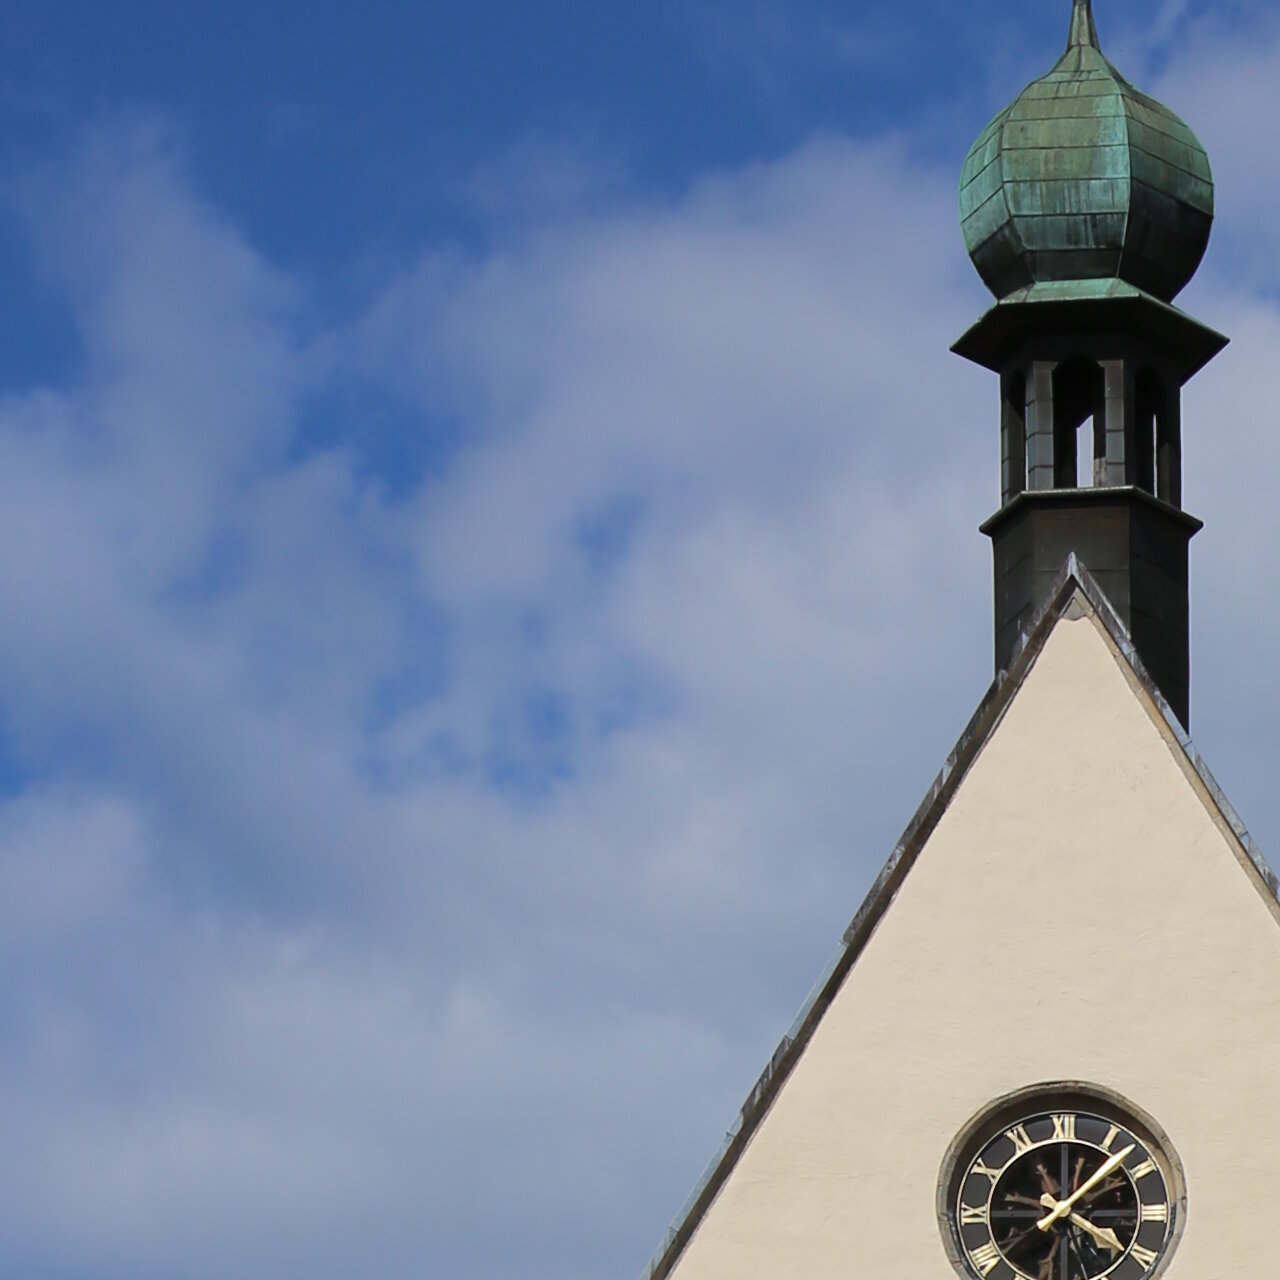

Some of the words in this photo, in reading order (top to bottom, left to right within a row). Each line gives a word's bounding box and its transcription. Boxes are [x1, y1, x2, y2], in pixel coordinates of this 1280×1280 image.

[1004, 1123, 1032, 1155] XI
[1050, 1114, 1076, 1140] XII
[971, 1157, 1001, 1184] X
[1141, 1203, 1167, 1222] III
